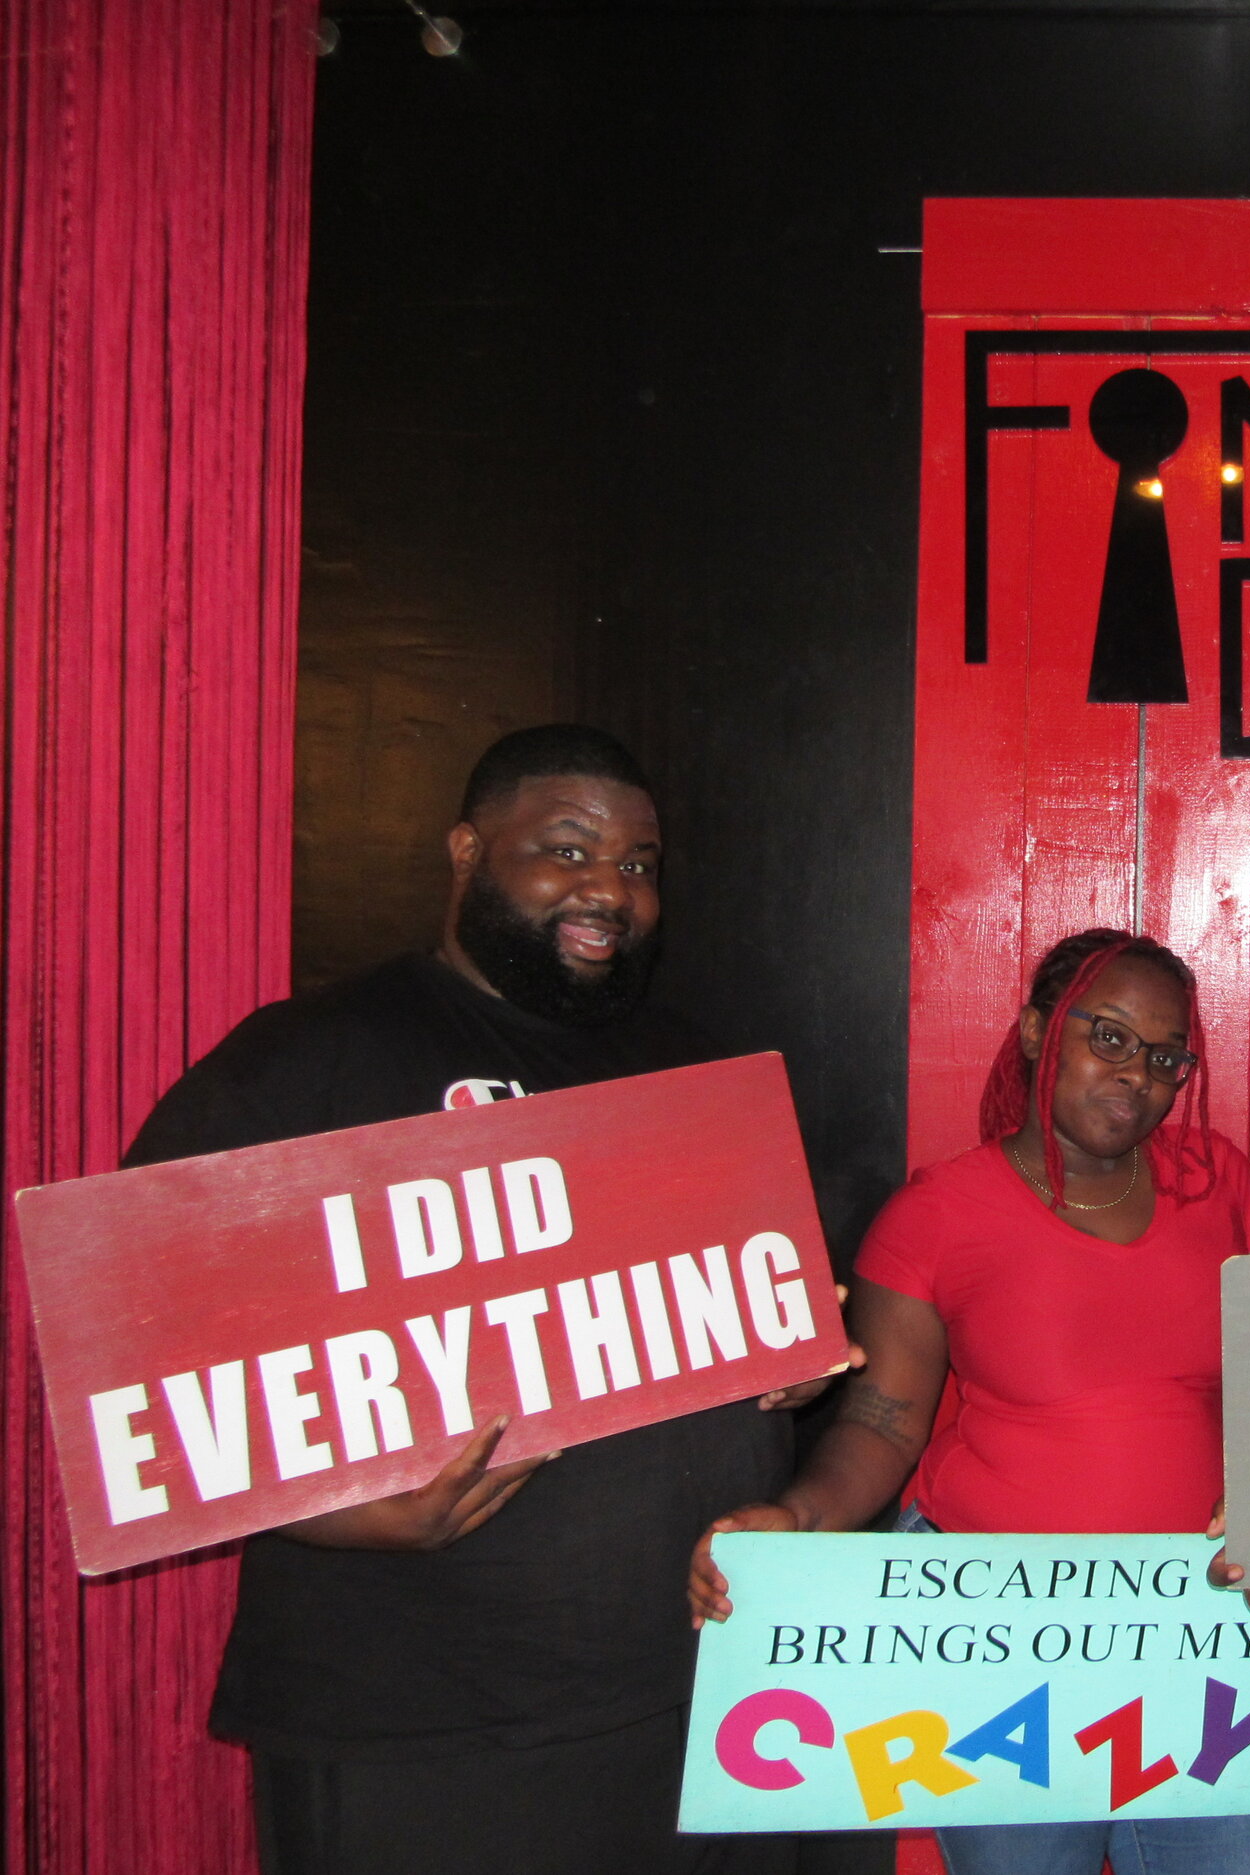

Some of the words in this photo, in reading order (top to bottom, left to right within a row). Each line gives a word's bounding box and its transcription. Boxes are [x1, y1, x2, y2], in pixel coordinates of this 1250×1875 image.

[323, 1193, 368, 1294] I
[388, 1156, 574, 1280] DID
[89, 1231, 816, 1525] EVERYTHING
[877, 1558, 1192, 1600] ESCAPING
[768, 1622, 1012, 1665] BRINGS
[1031, 1622, 1159, 1662] OUT
